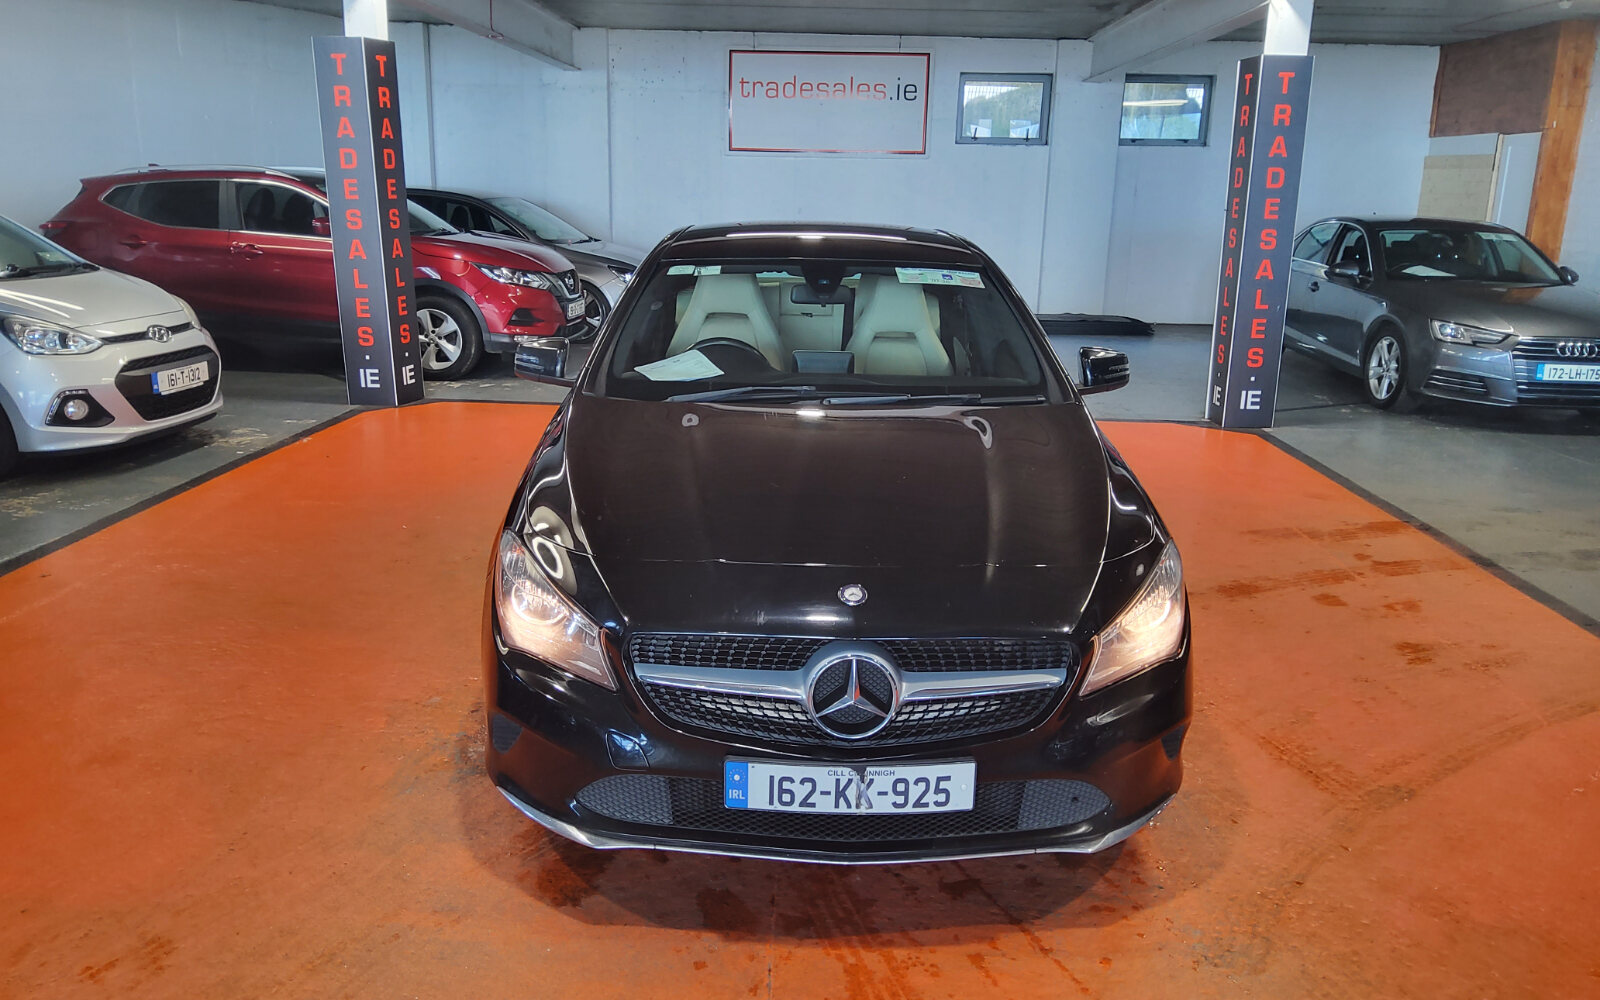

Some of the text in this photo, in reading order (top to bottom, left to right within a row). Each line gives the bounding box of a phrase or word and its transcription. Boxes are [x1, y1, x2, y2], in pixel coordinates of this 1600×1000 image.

[739, 75, 918, 101] tradesales.ie
[167, 367, 201, 388] 161-T-1312
[827, 769, 846, 777] CILL
[728, 788, 746, 801] IRL
[768, 774, 952, 811] 162-KK-925
